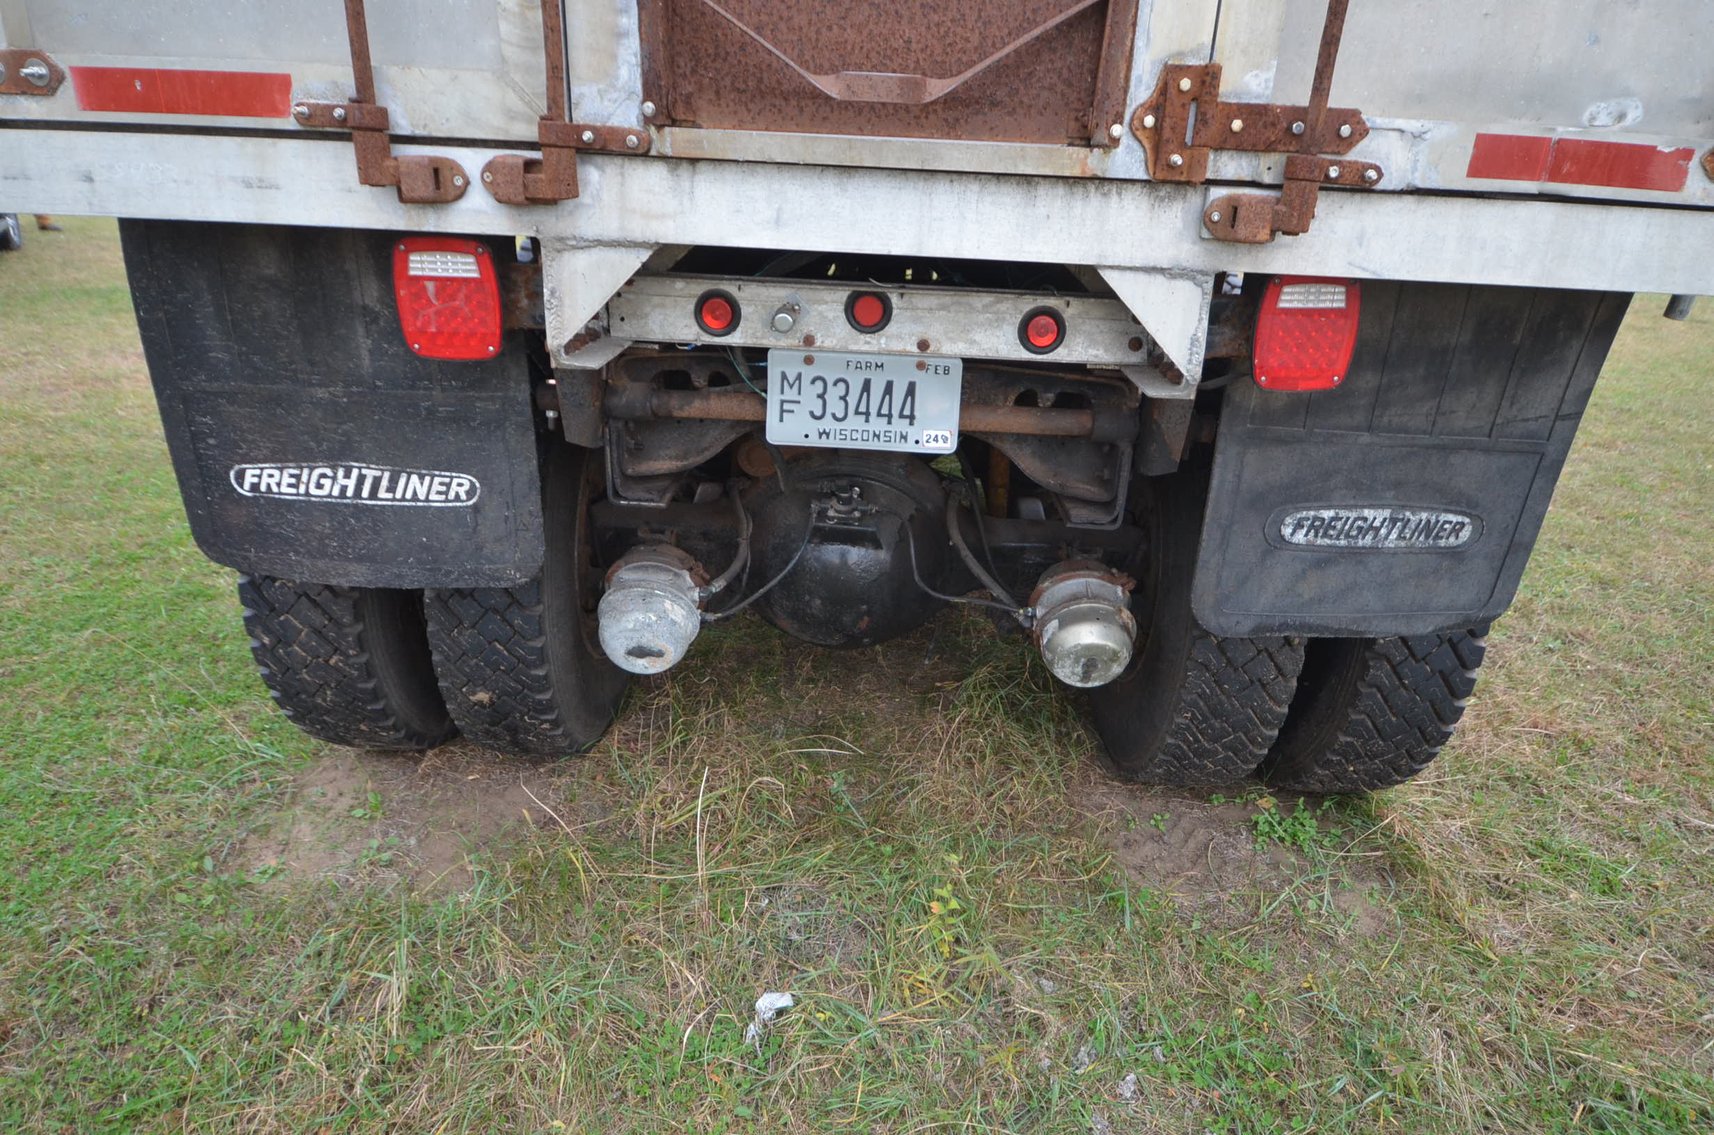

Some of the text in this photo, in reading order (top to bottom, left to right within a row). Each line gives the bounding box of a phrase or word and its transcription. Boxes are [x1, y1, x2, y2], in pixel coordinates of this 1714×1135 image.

[846, 360, 885, 372] FARM
[925, 363, 951, 376] FEB
[808, 375, 917, 426] 33444
[817, 427, 908, 444] WISCONSIN
[243, 467, 471, 501] FREIGHTLINER
[1289, 516, 1466, 541] FREIGHTLINER
